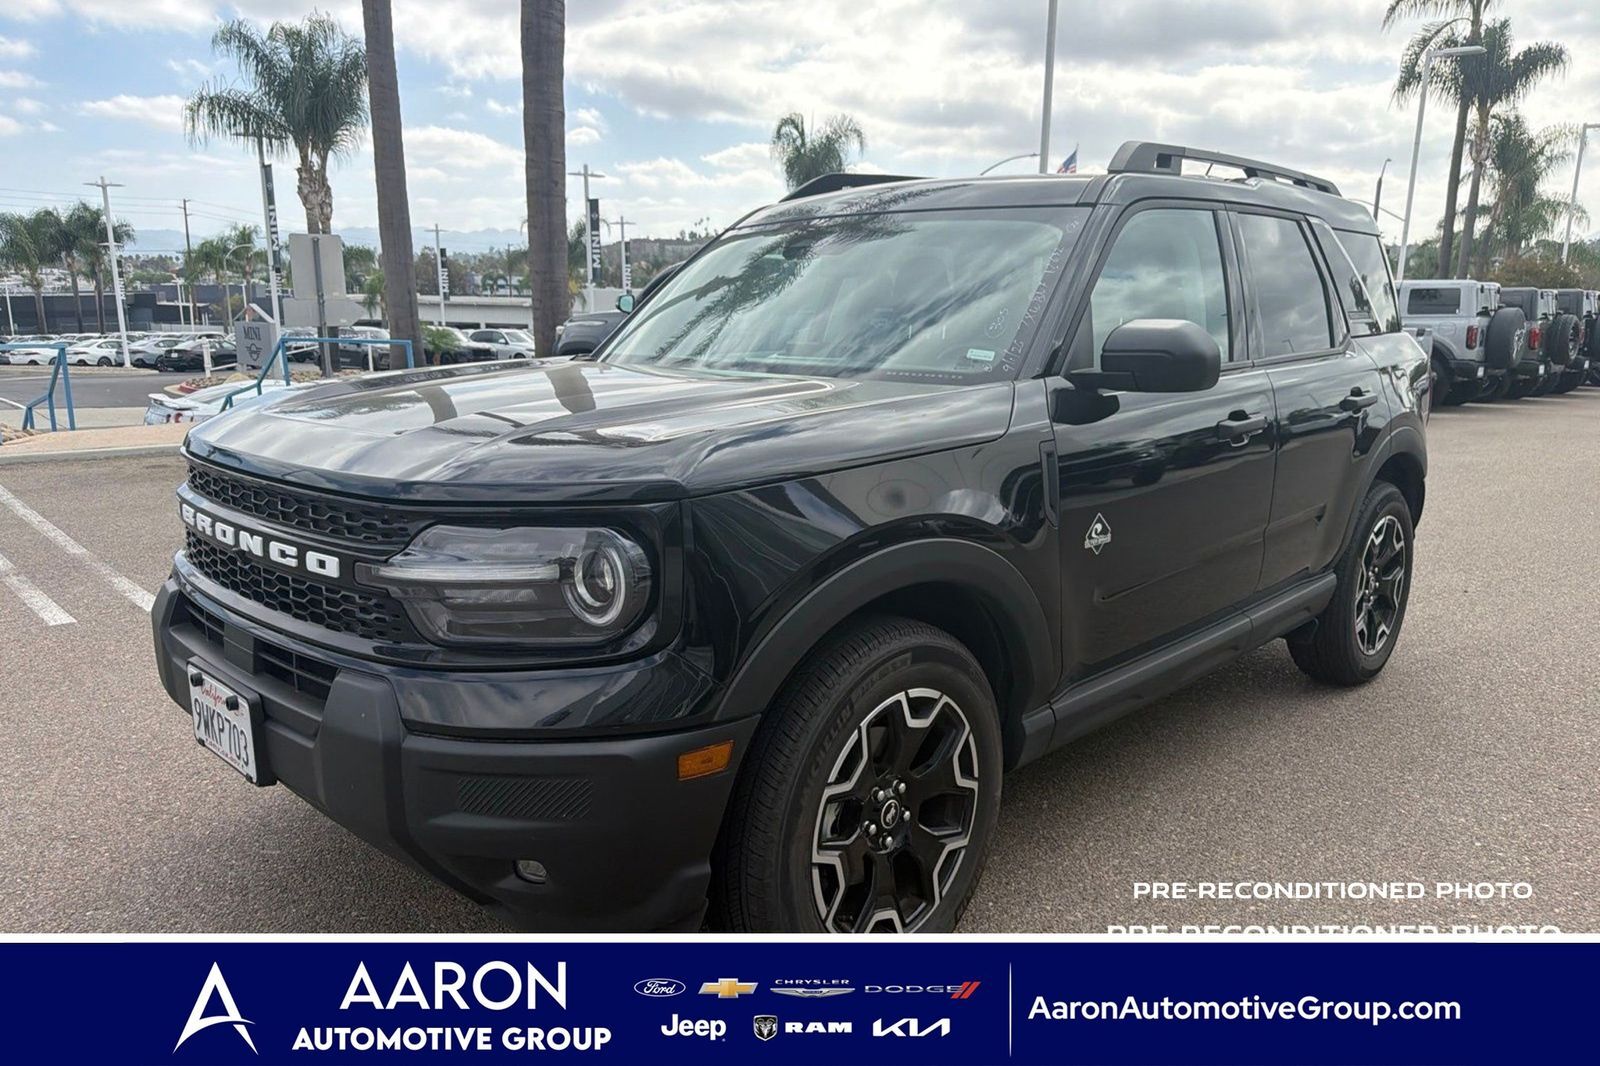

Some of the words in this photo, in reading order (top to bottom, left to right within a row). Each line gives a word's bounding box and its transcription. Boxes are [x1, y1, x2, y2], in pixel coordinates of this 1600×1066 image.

[268, 205, 280, 251] MINI
[591, 231, 601, 268] MINI
[440, 268, 449, 293] MINI
[243, 326, 262, 342] MINI
[181, 504, 340, 578] BRONCO
[193, 697, 249, 767] 9WKP703
